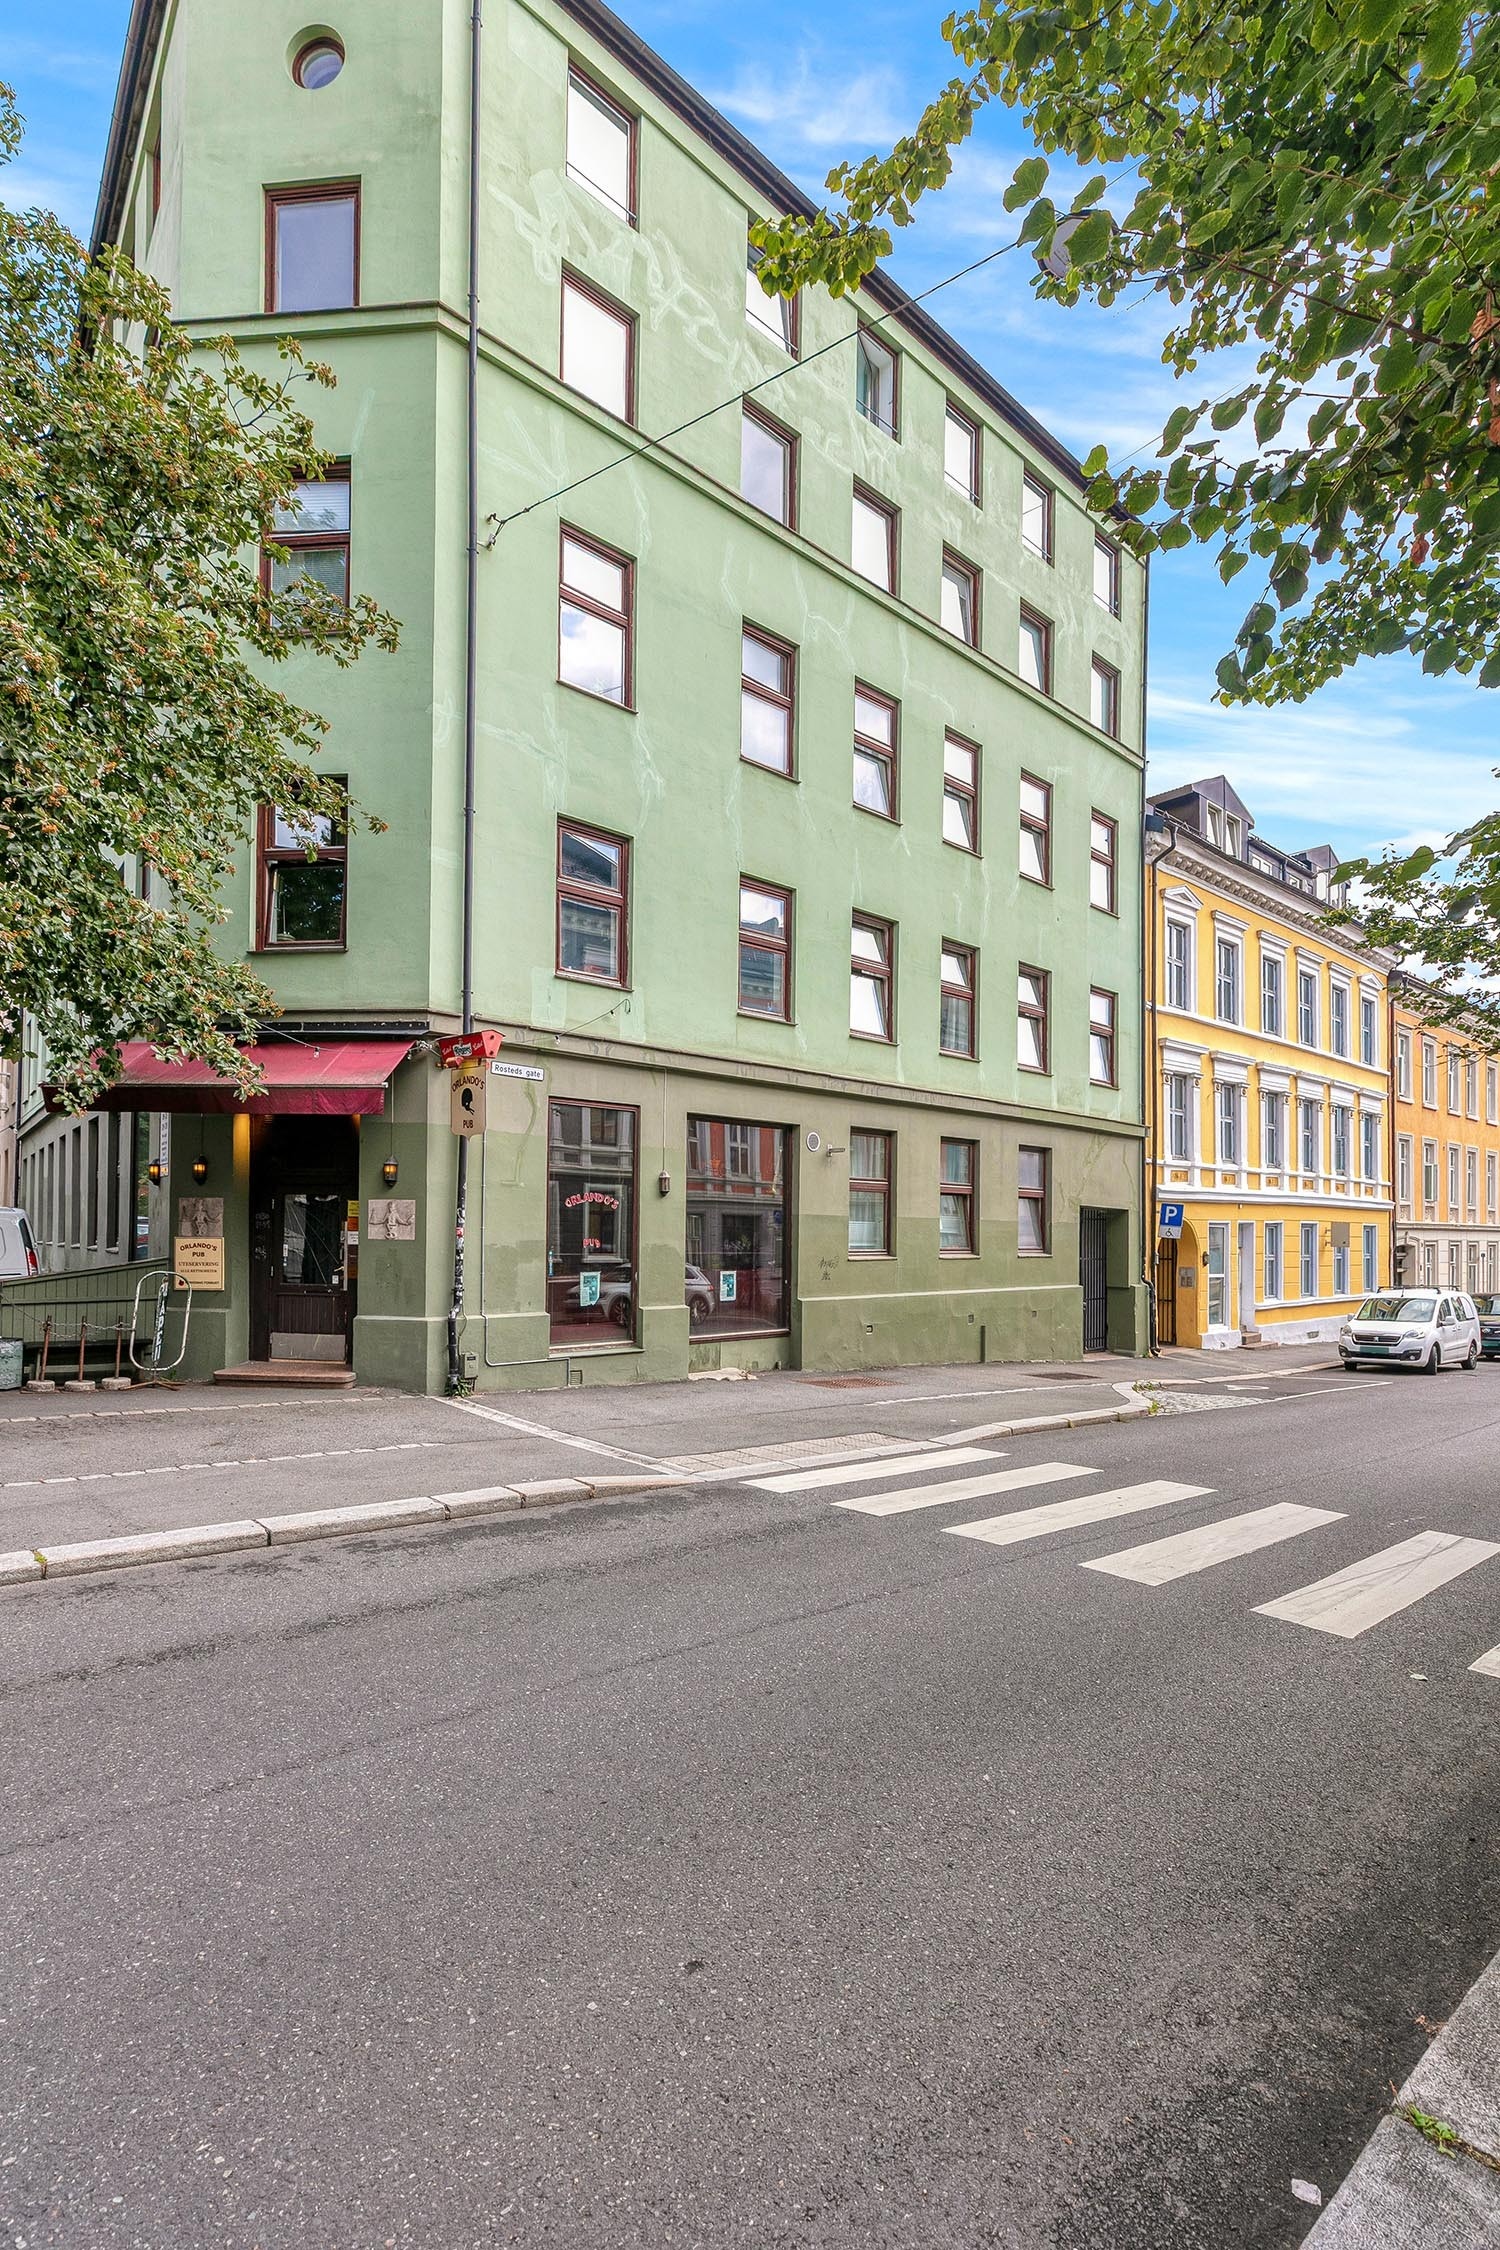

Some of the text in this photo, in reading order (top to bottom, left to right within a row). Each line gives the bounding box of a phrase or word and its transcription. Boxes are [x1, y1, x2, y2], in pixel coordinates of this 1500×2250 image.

[494, 1064, 541, 1078] Rosteds gate
[452, 1076, 485, 1092] ORLANDO'S
[463, 1120, 473, 1128] PUB
[565, 1192, 619, 1209] ORLANDO'S
[1164, 1205, 1178, 1224] P
[180, 1243, 217, 1251] ORLANDO'S
